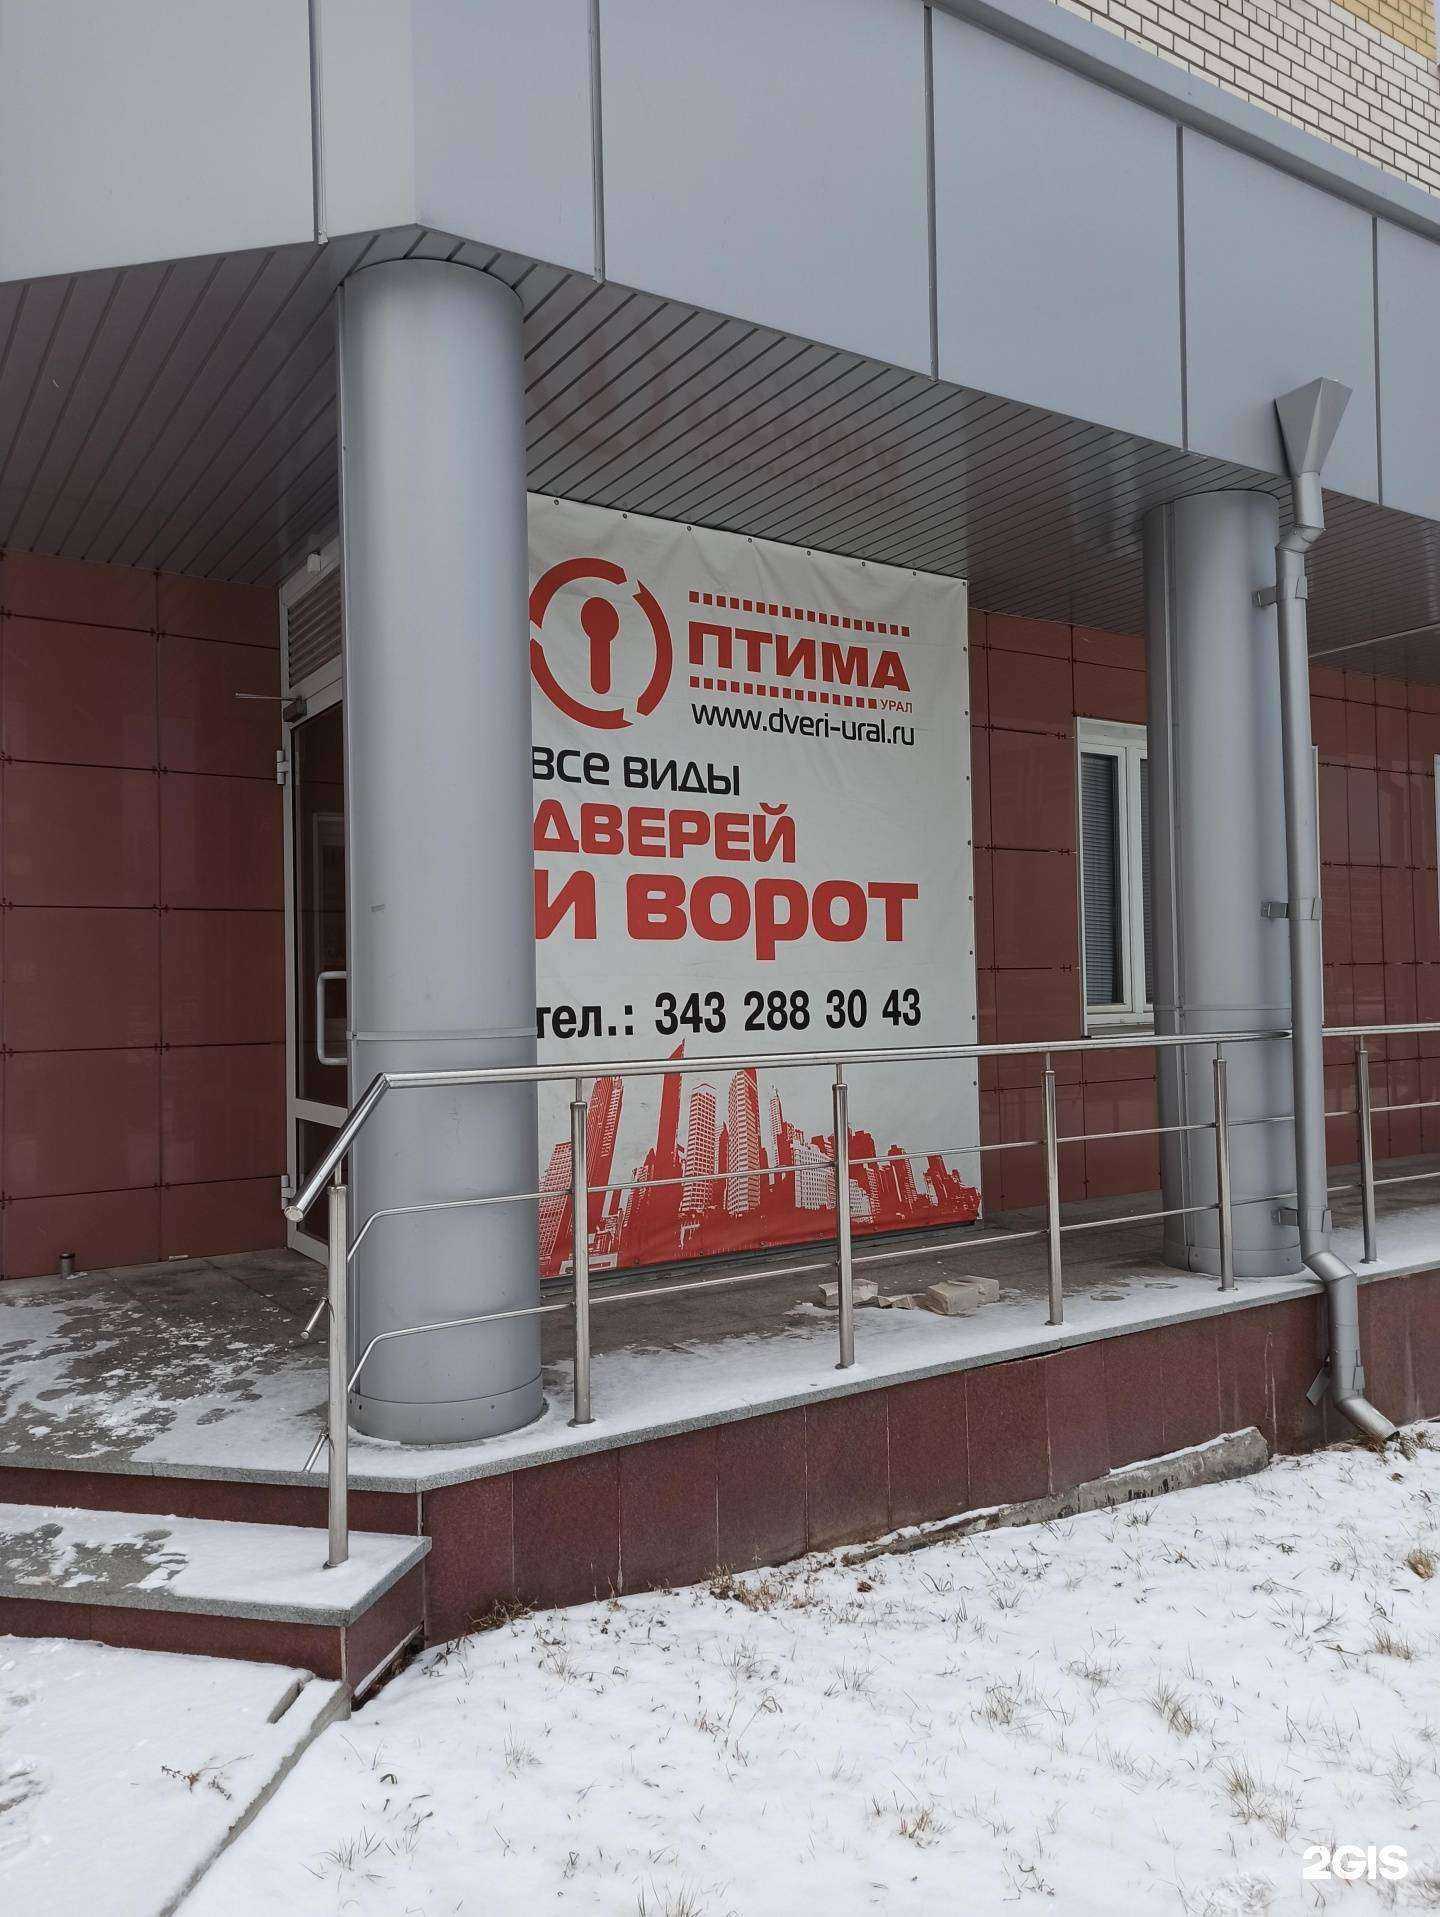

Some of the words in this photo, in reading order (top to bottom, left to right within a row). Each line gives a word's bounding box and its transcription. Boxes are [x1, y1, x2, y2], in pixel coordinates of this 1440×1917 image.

[691, 703, 915, 746] www.dveri-ural.ru
[881, 698, 913, 714] УРАЛ
[534, 799, 796, 863] ДВЕРЕЙ
[654, 991, 727, 1035] 343
[743, 988, 811, 1032] 288
[825, 988, 868, 1030] 30
[881, 987, 922, 1027] 43
